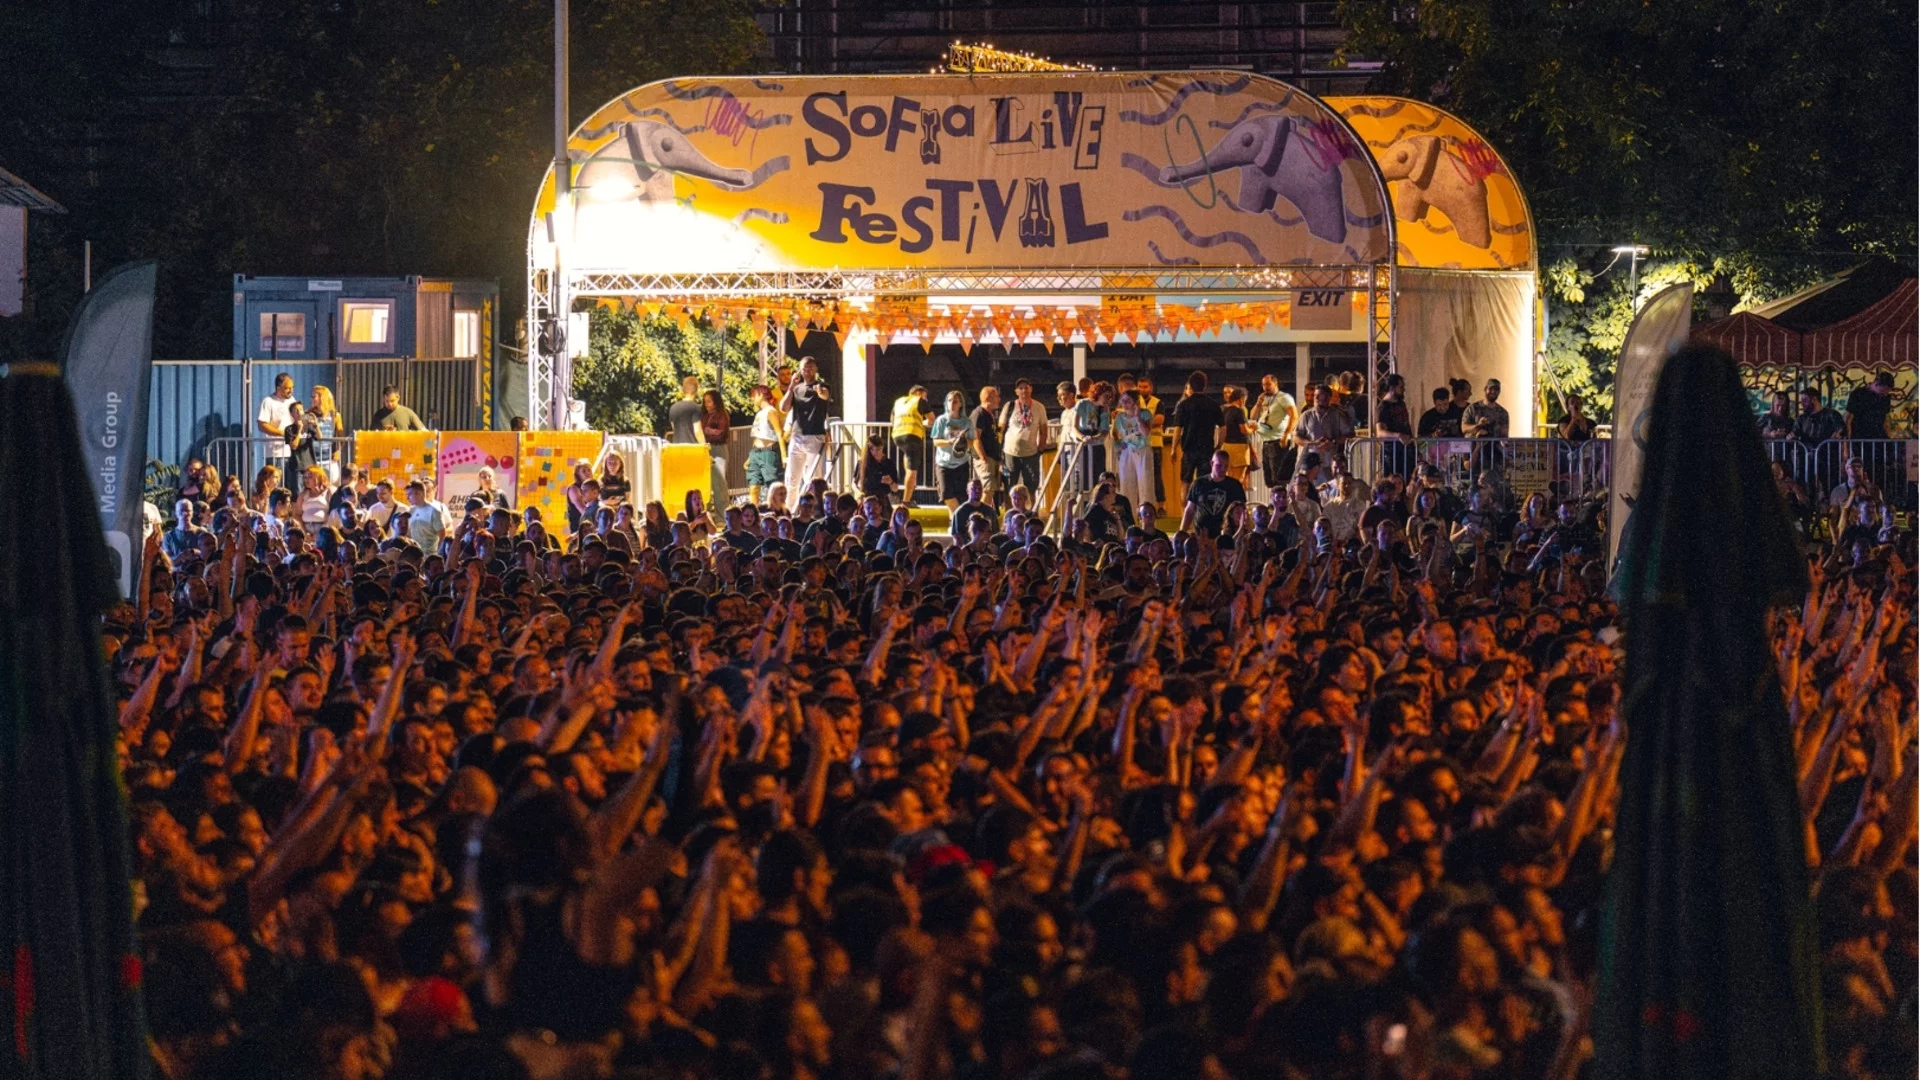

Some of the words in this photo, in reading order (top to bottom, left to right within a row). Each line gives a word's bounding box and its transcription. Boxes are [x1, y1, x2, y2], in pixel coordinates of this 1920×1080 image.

[1297, 290, 1346, 307] EXIT
[482, 298, 492, 431] NTAINEX
[102, 391, 123, 449] Group
[101, 455, 116, 514] Media
